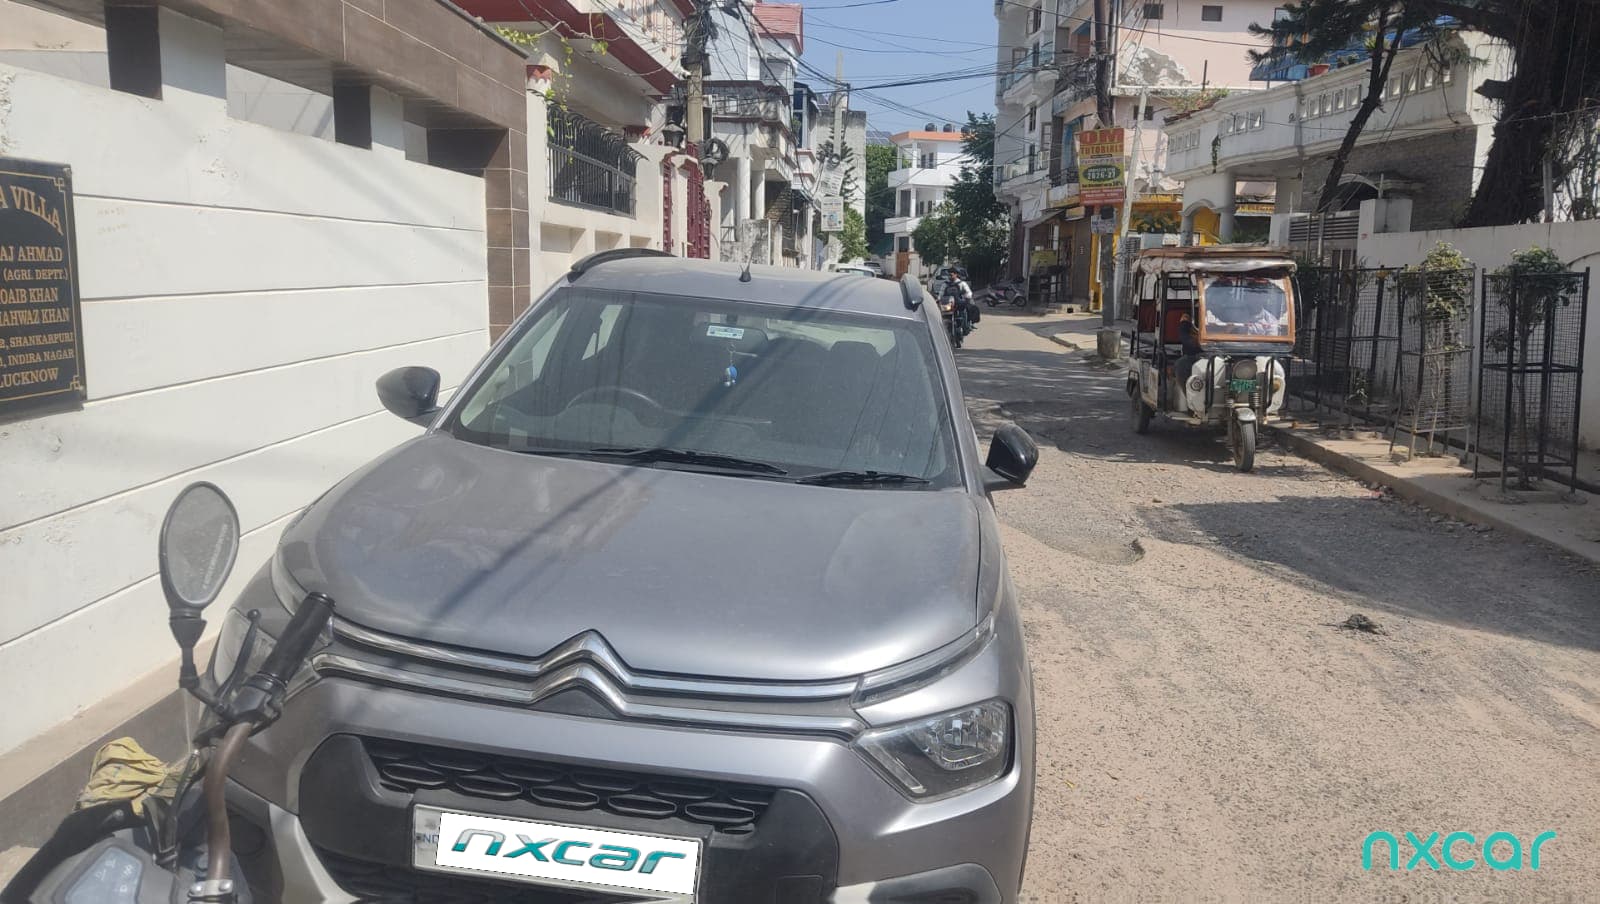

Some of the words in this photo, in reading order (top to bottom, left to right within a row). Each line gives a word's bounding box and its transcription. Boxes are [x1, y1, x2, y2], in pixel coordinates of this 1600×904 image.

[10, 185, 64, 236] VILLA
[18, 246, 63, 262] AHMAD
[28, 287, 58, 303] KHAN
[0, 309, 40, 327] AHWAZ
[41, 307, 69, 324] KHAN
[9, 332, 74, 349] SHANKARPURI
[8, 352, 41, 366] INDIRA
[43, 348, 75, 361] NAGAR
